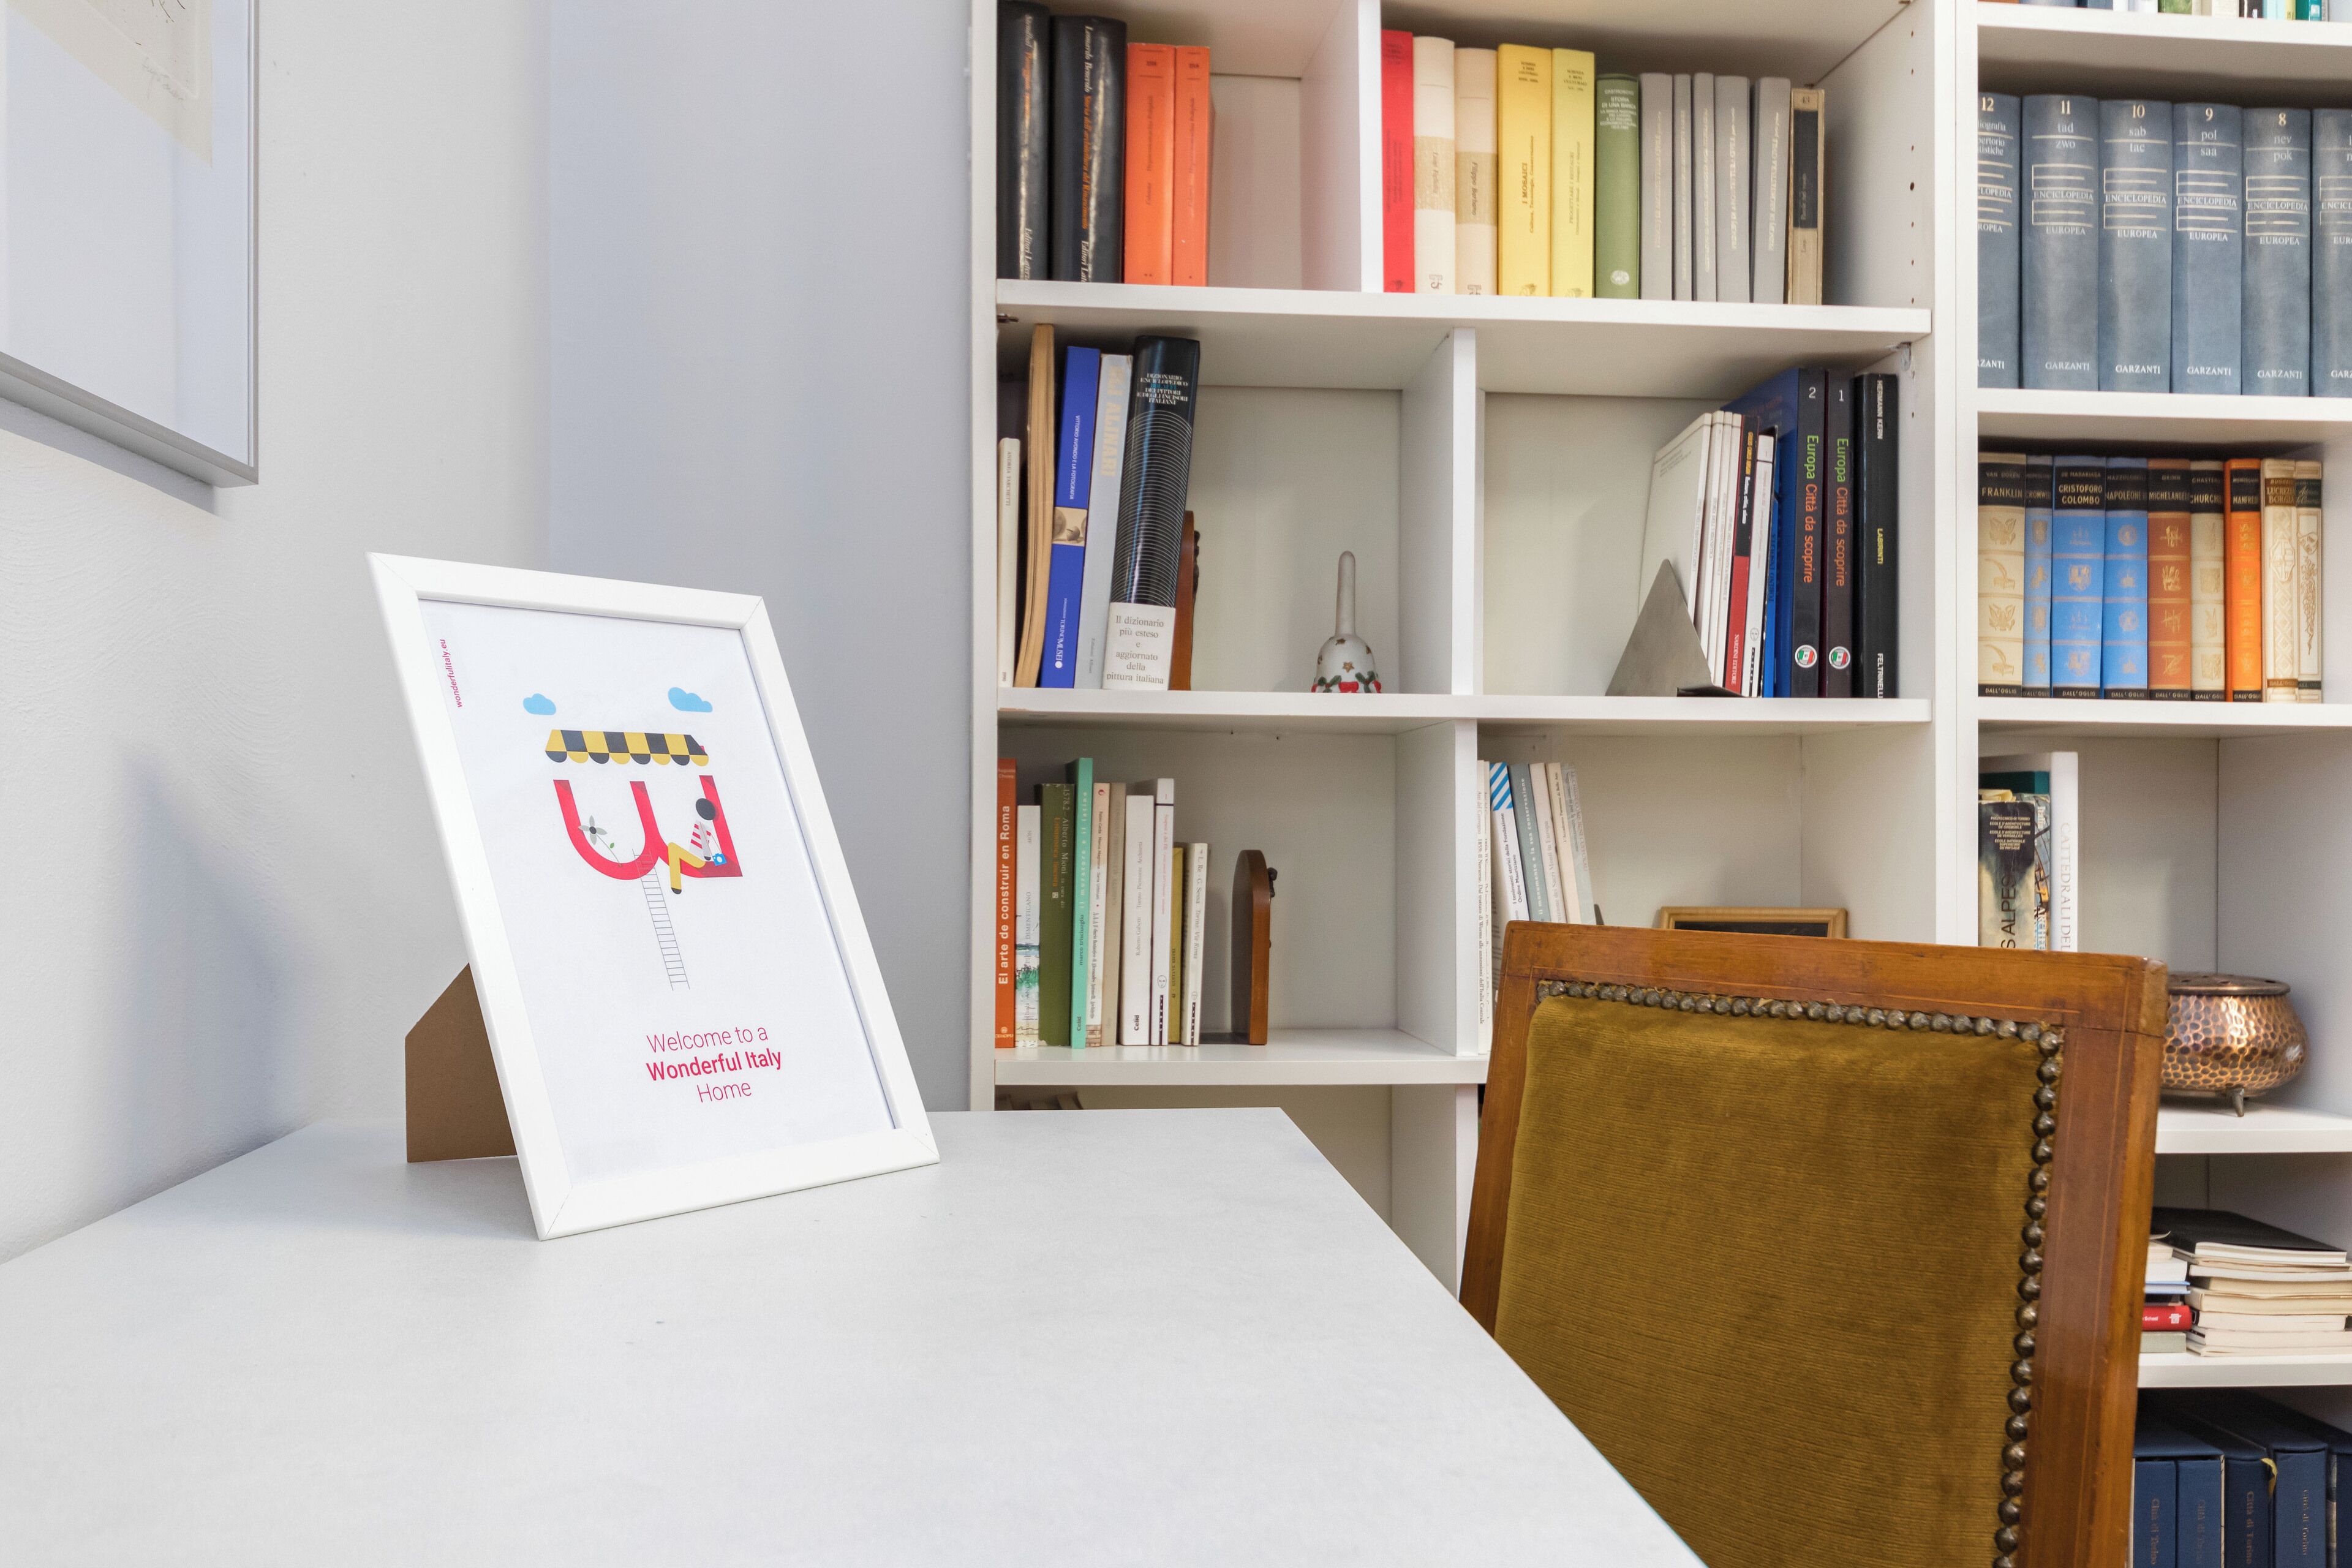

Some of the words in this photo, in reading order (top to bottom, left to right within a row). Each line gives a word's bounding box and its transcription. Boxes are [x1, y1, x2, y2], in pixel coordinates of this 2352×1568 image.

[1084, 28, 1093, 61] Leonardo
[1084, 62, 1092, 92] Benevolo
[1981, 96, 1995, 112] 12
[2060, 100, 2071, 115] 11
[2132, 104, 2146, 119] 10
[2205, 107, 2214, 121] 9
[2278, 112, 2286, 127] 8
[2128, 125, 2147, 137] sab
[2201, 129, 2217, 143] pol
[2274, 134, 2293, 145] nev
[2200, 147, 2217, 157] saa
[2273, 149, 2293, 162] pok
[2033, 189, 2094, 202] ENCICLOPEDIA
[2105, 194, 2167, 205] ENCICLOPEDIA
[2177, 197, 2237, 208] ENCICLOPEDIA
[2247, 200, 2308, 211] ENCICLOPEDIA
[2046, 225, 2086, 236] EUROPEA
[2117, 230, 2158, 239] EUROPEA
[2189, 232, 2228, 242] EUROPEA
[2259, 235, 2300, 246] EUROPEA
[2045, 361, 2090, 371] GARZANTI
[2115, 364, 2161, 375] GARZANTI
[2187, 366, 2231, 376] GARZANTI
[1140, 377, 1189, 386] ENCICLOPEDICO
[1147, 372, 1183, 381] DIZIONARIO
[2256, 369, 2303, 380] GARZANTI
[1809, 386, 1817, 399] 2
[1839, 389, 1844, 402] 1
[1803, 435, 1819, 480] Europa
[1834, 438, 1849, 483] Europa
[1981, 487, 2023, 499] FRANKLIN
[2059, 484, 2103, 494] CRISTOFORO
[1804, 484, 1818, 513] Città
[1836, 486, 1849, 515] Città
[2062, 495, 2100, 505] COLOMBO
[1804, 516, 1815, 532] da
[1836, 519, 1847, 535] da
[1802, 534, 1815, 584] scoprire
[1834, 538, 1847, 587] scoprire
[1116, 615, 1121, 624] Il
[1124, 616, 1164, 628] dizionario
[1120, 627, 1133, 637] più
[1116, 650, 1158, 662] aggiornato
[439, 638, 463, 708] wonderfulitaly.eu
[1127, 662, 1146, 671] della
[1106, 672, 1133, 682] pittura
[1136, 674, 1164, 684] italiana
[1520, 778, 1531, 830] conservazione
[1000, 805, 1010, 840] Roma
[1061, 817, 1069, 848] Alberto
[1000, 841, 1009, 860] en
[1060, 852, 1069, 875] Mioni
[2060, 823, 2071, 919] CATTEDRALI
[999, 864, 1009, 919] construir
[1533, 863, 1543, 907] monumento
[2001, 876, 2016, 936] ALPES
[998, 924, 1009, 940] de
[998, 943, 1009, 968] arte
[998, 973, 1008, 985] El
[646, 1031, 733, 1053] Welcome
[735, 1027, 754, 1044] to
[758, 1027, 769, 1041] a
[646, 1052, 743, 1082] Wonderful
[745, 1048, 782, 1071] Italy
[696, 1082, 753, 1103] Home
